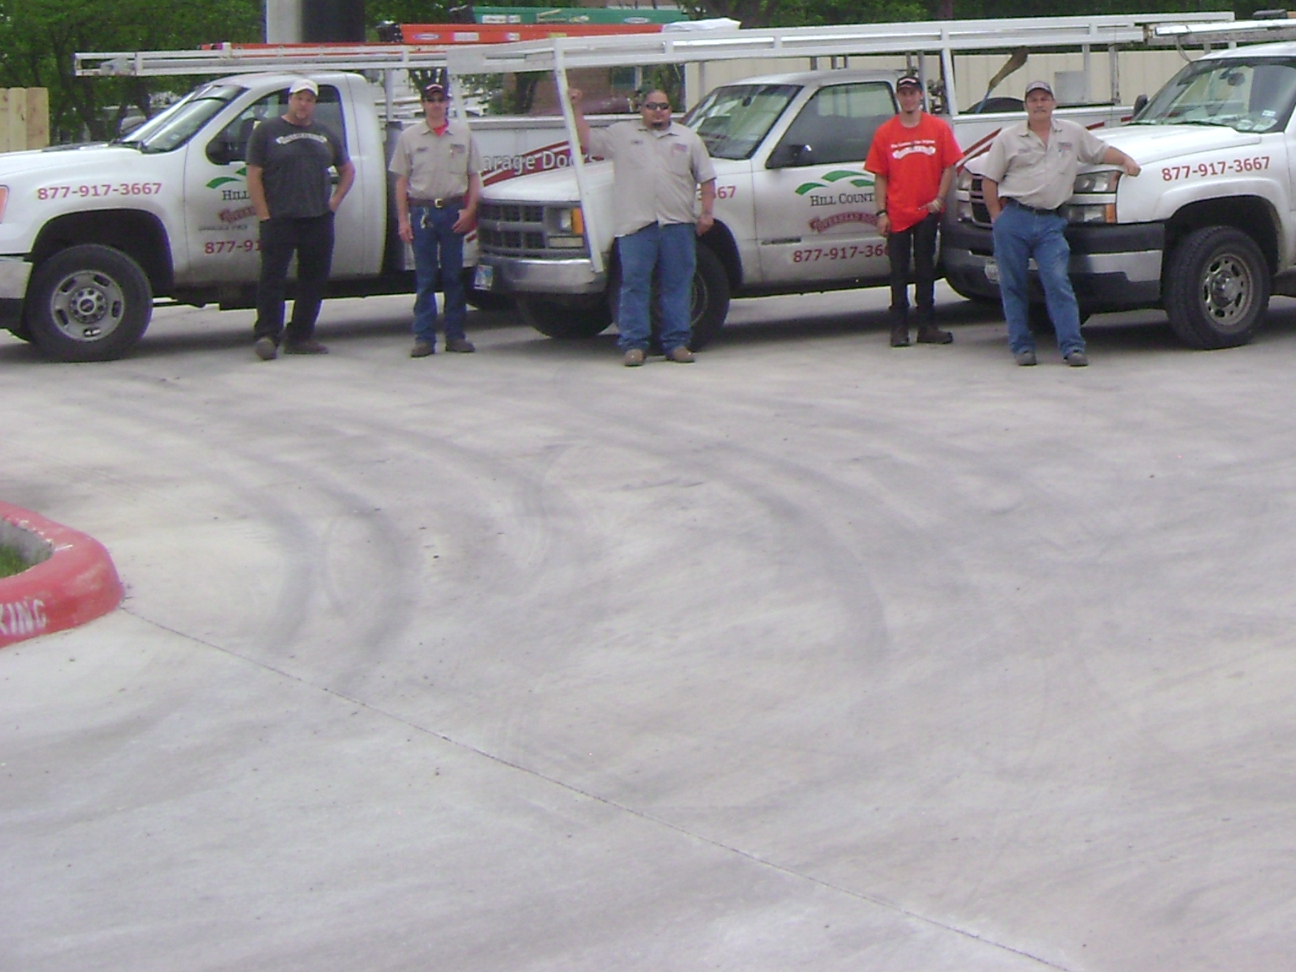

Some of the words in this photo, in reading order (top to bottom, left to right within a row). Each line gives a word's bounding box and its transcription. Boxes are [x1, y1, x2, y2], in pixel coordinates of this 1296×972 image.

[482, 154, 536, 175] arage
[1162, 156, 1270, 181] 877-917-3667
[37, 183, 162, 200] 877-917-3667
[810, 195, 836, 206] HILL
[839, 193, 874, 204] COUNT
